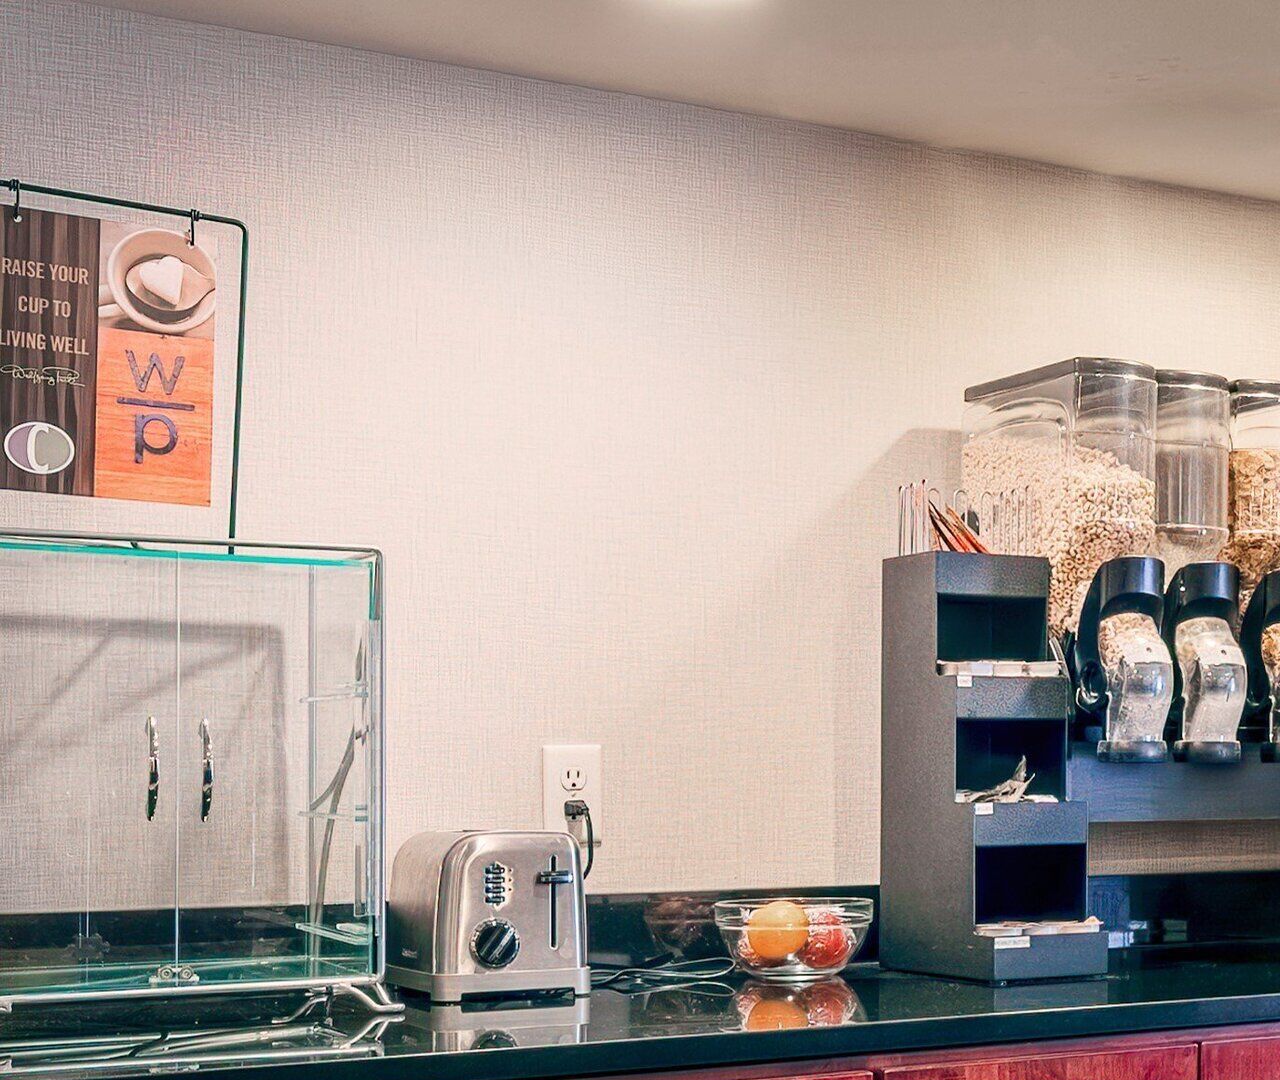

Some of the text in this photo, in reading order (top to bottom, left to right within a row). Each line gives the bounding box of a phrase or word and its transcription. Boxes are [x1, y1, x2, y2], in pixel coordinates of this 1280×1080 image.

[1, 256, 89, 286] RAISE YOUR
[17, 295, 72, 318] CUP TO
[0, 328, 90, 356] LIVING WELL
